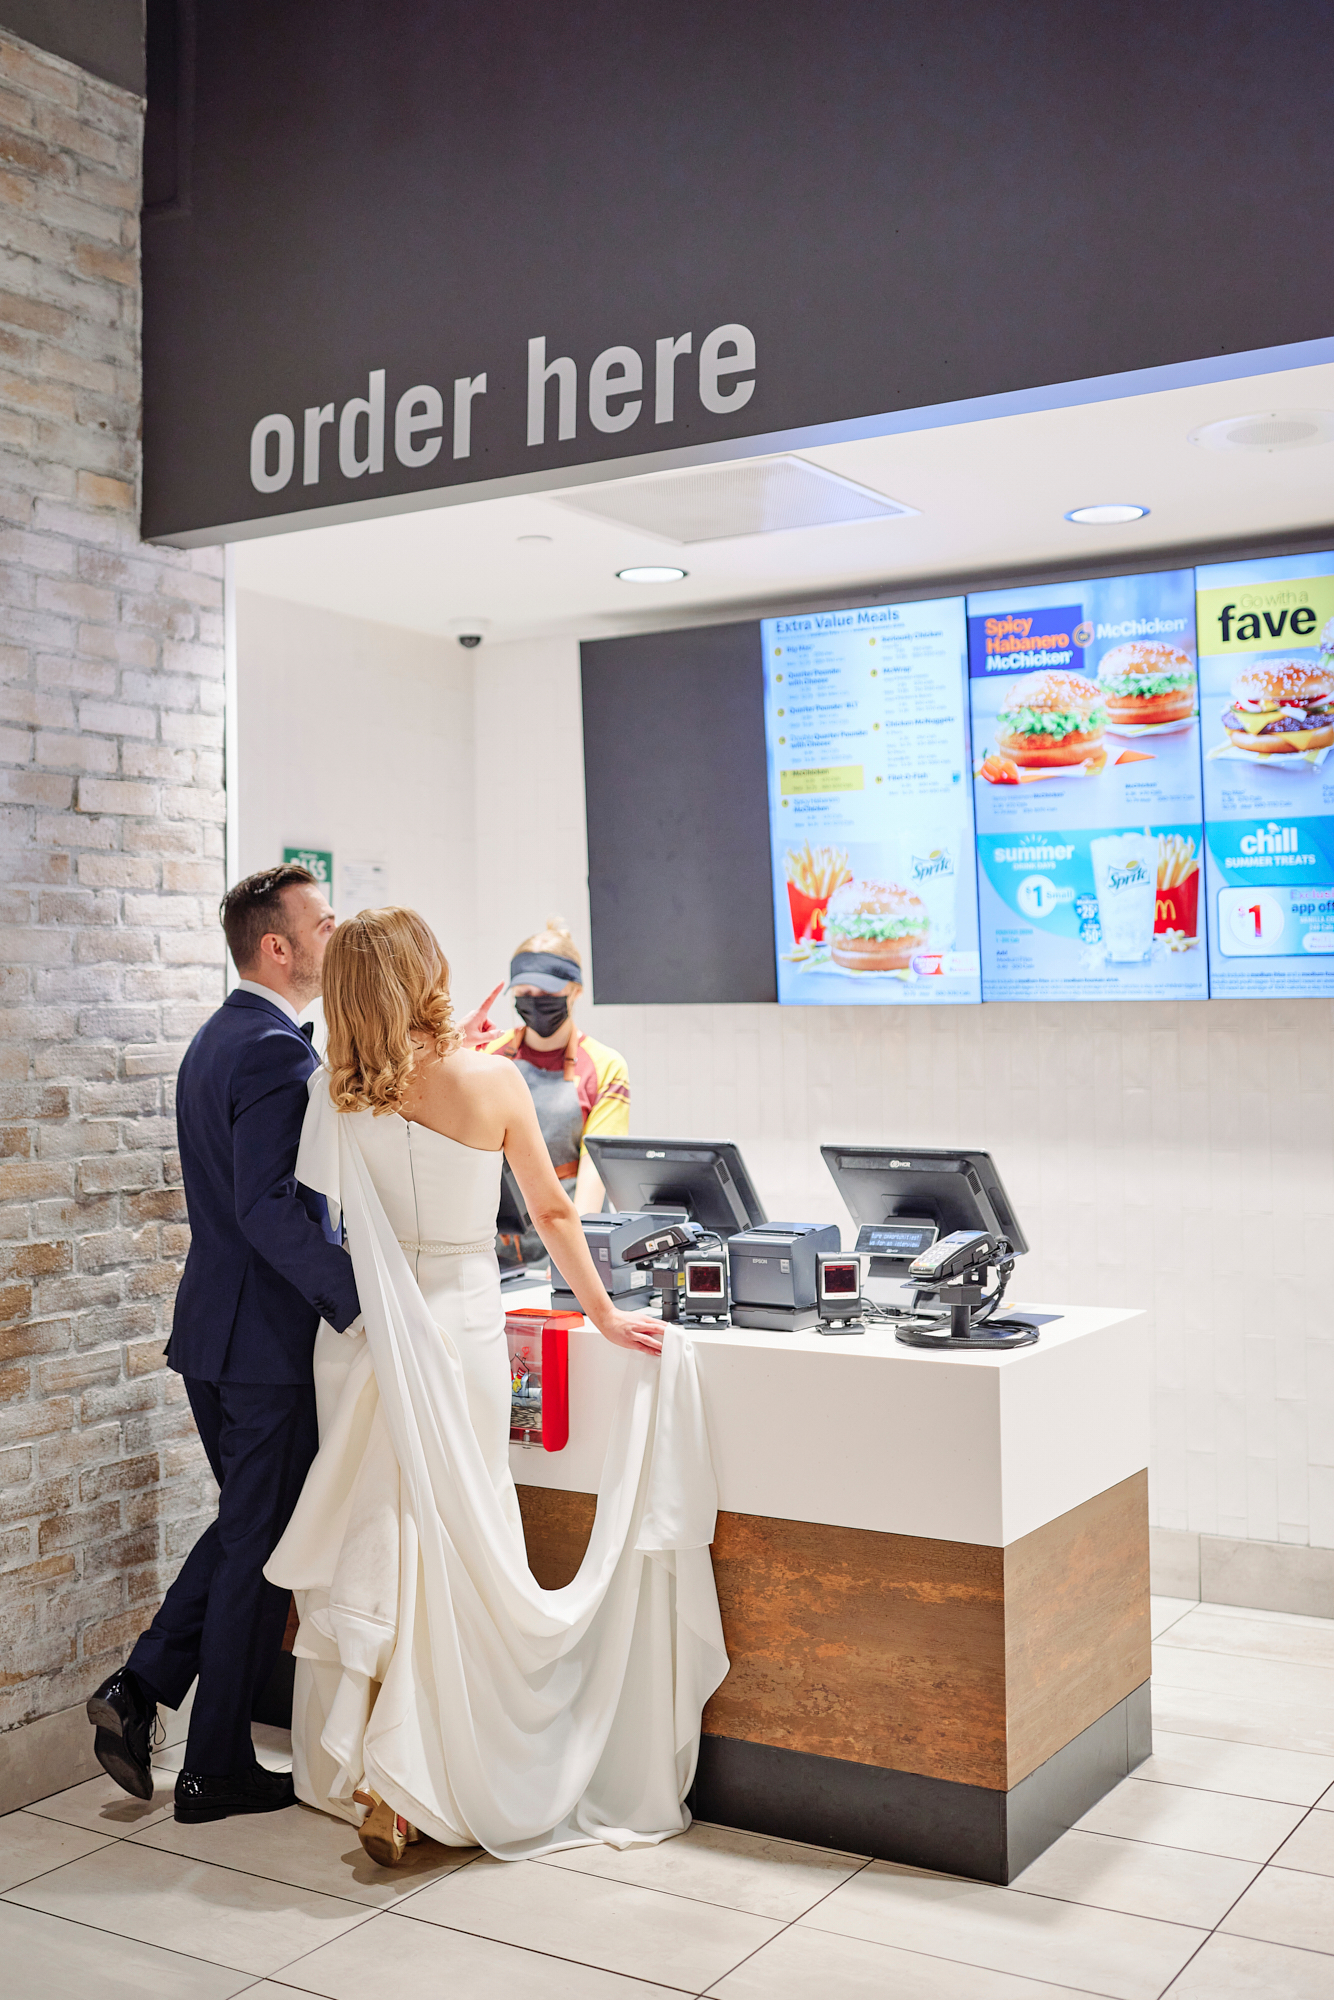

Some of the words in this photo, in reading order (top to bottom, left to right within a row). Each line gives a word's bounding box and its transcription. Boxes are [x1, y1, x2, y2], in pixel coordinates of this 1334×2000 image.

[249, 369, 487, 494] order
[526, 322, 757, 447] here
[1240, 593, 1263, 609] Go
[1265, 590, 1297, 607] with
[1299, 591, 1309, 604] a
[776, 618, 812, 633] Extra
[815, 614, 853, 631] Value
[857, 606, 900, 624] Meals
[984, 615, 1033, 637] Spicy
[1096, 617, 1187, 640] McChicken
[1217, 604, 1317, 642] fave
[985, 633, 1070, 655] Habanero
[985, 650, 1073, 672] McChicken
[1240, 824, 1298, 855] chill
[994, 844, 1075, 863] summer
[1225, 855, 1274, 869] SUMMER
[1274, 853, 1317, 867] TREATS
[912, 857, 951, 882] Sprite
[1108, 867, 1149, 890] Sprite
[1291, 902, 1316, 914] app
